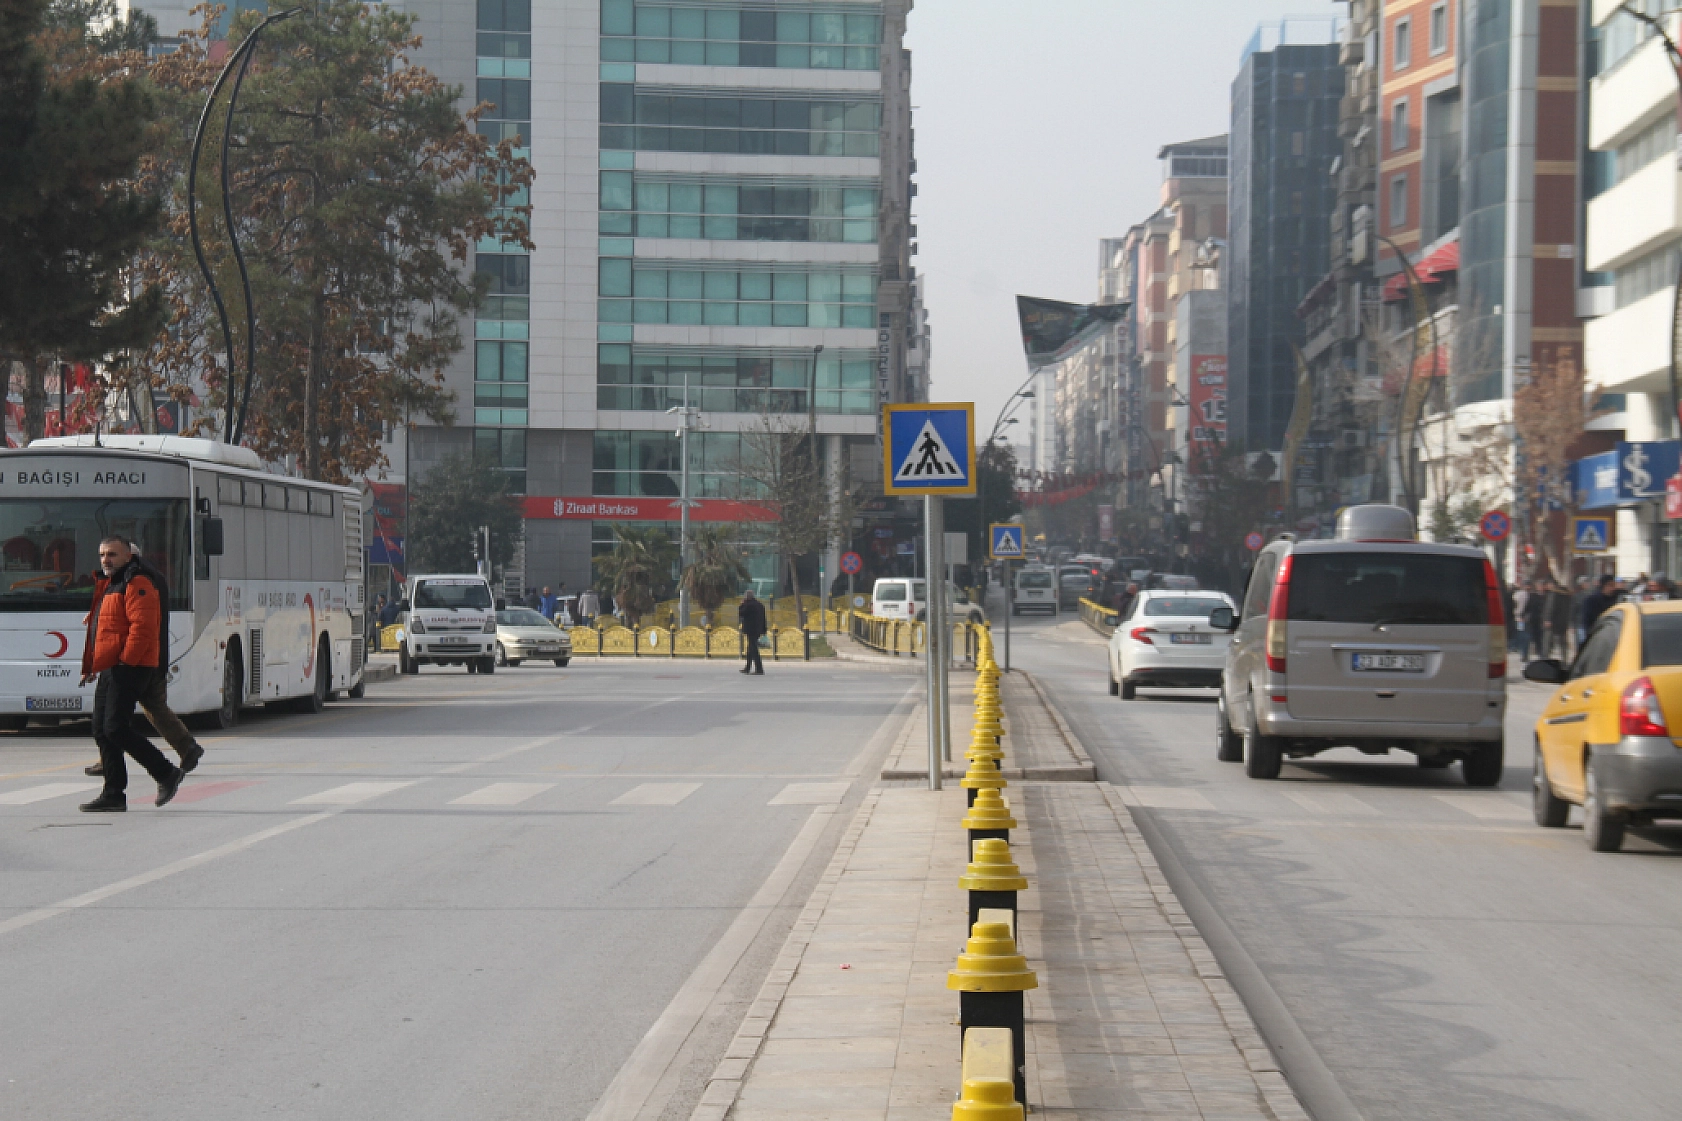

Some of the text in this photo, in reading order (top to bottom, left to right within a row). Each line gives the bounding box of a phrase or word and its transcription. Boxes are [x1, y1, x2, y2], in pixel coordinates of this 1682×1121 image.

[17, 468, 80, 488] BAĞIŞI
[92, 471, 147, 485] ARACI
[566, 501, 639, 516] Ziraat Bankası
[36, 669, 72, 678] KIZILAY
